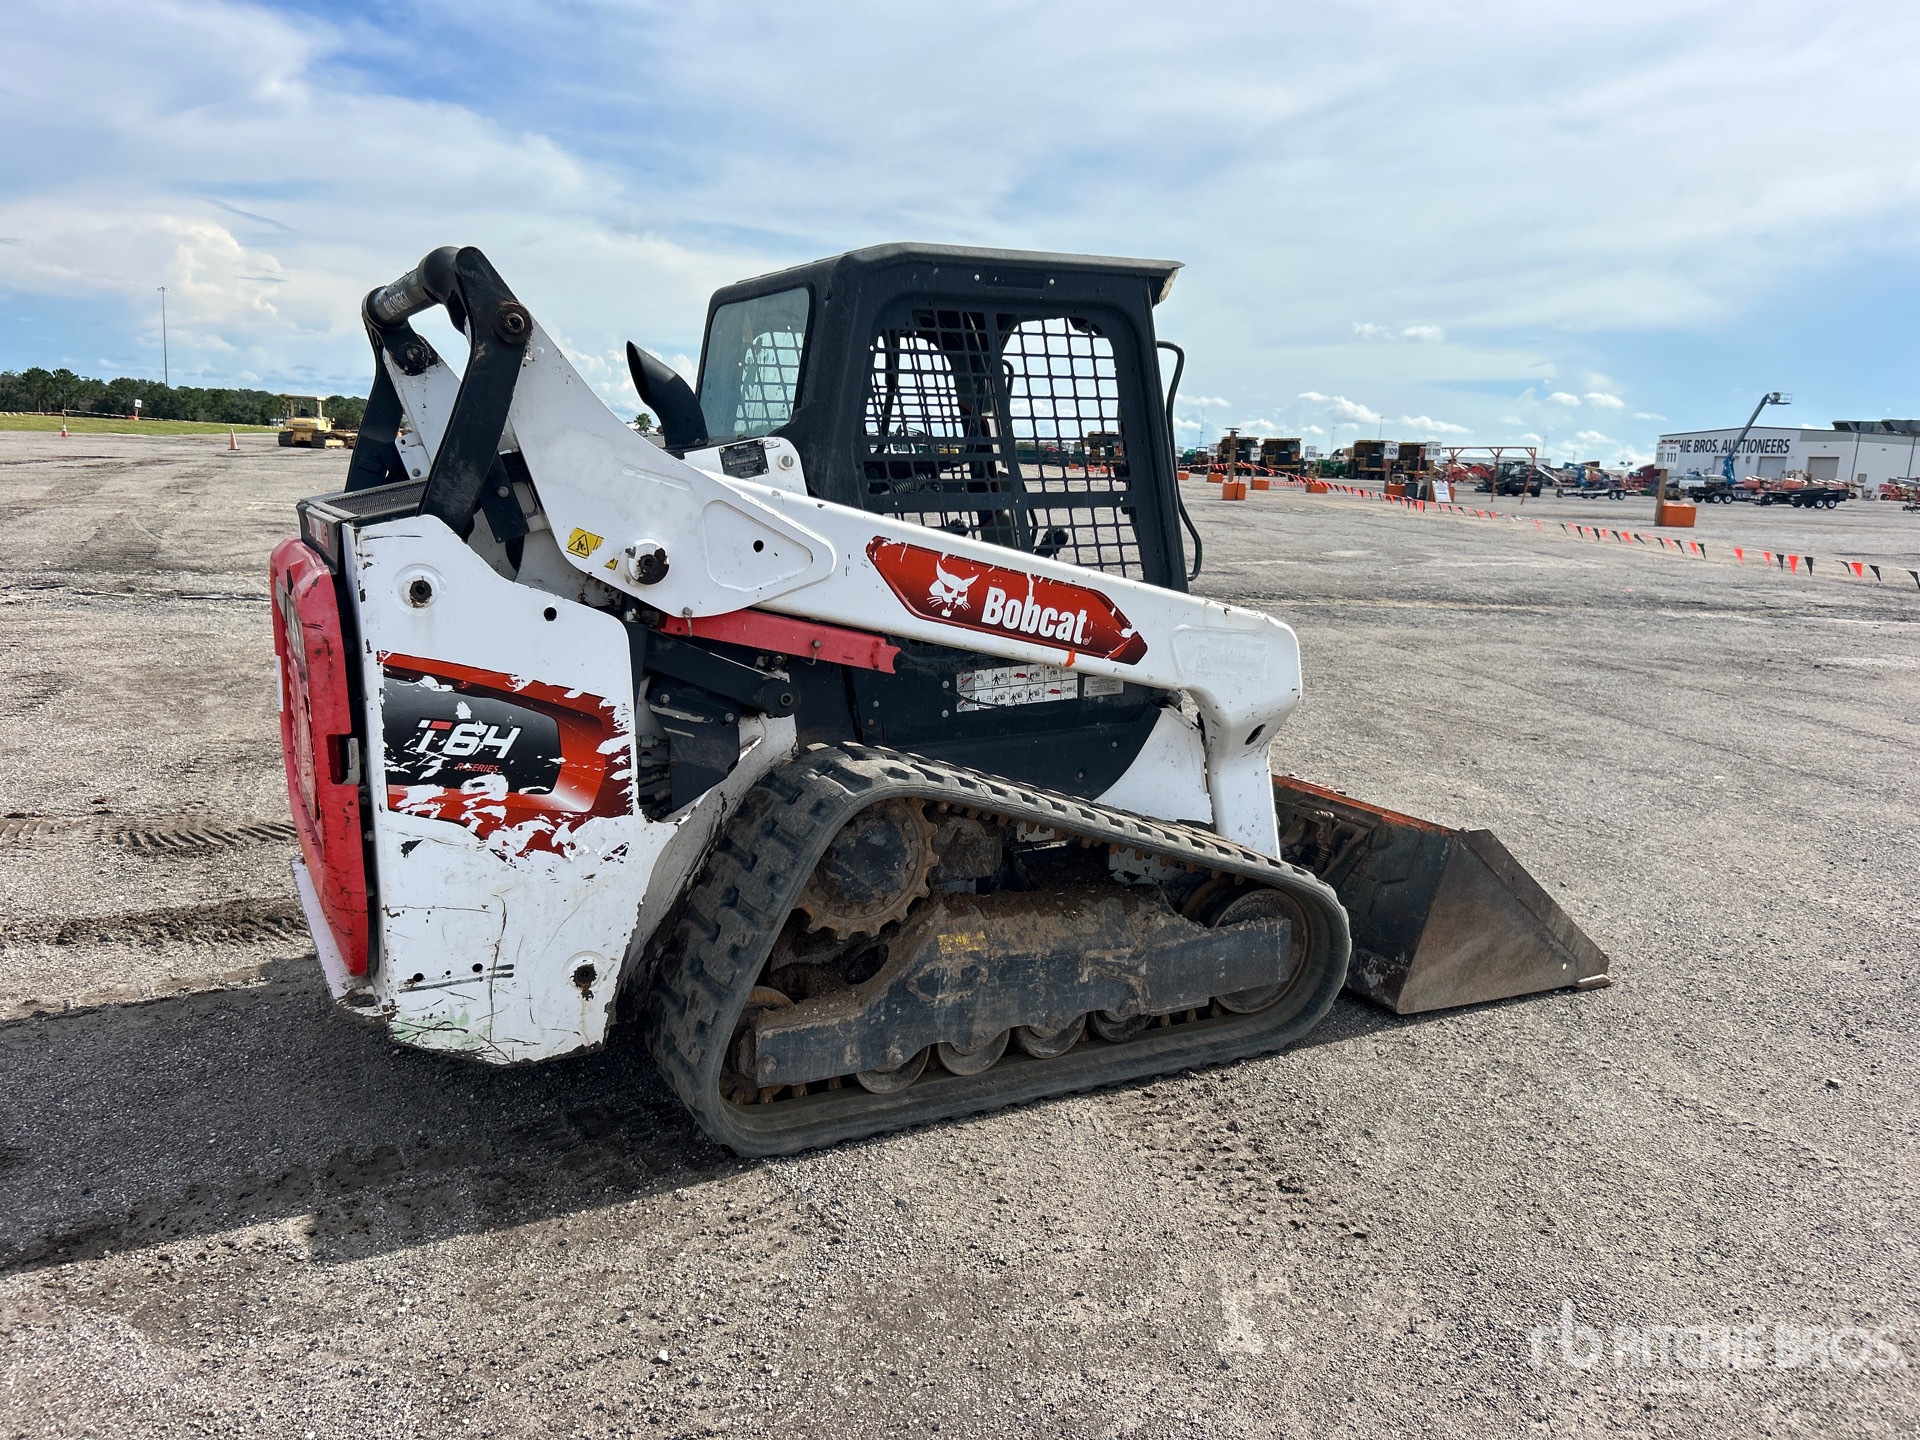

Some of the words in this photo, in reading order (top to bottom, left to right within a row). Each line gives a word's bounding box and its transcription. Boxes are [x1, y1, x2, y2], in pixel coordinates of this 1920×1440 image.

[1388, 447, 1398, 455] 109
[1693, 438, 1719, 453] BROS.
[1720, 438, 1790, 454] AUTIONEERS
[1432, 448, 1441, 456] 110
[1666, 452, 1677, 463] 111
[981, 586, 1088, 645] Bobcat
